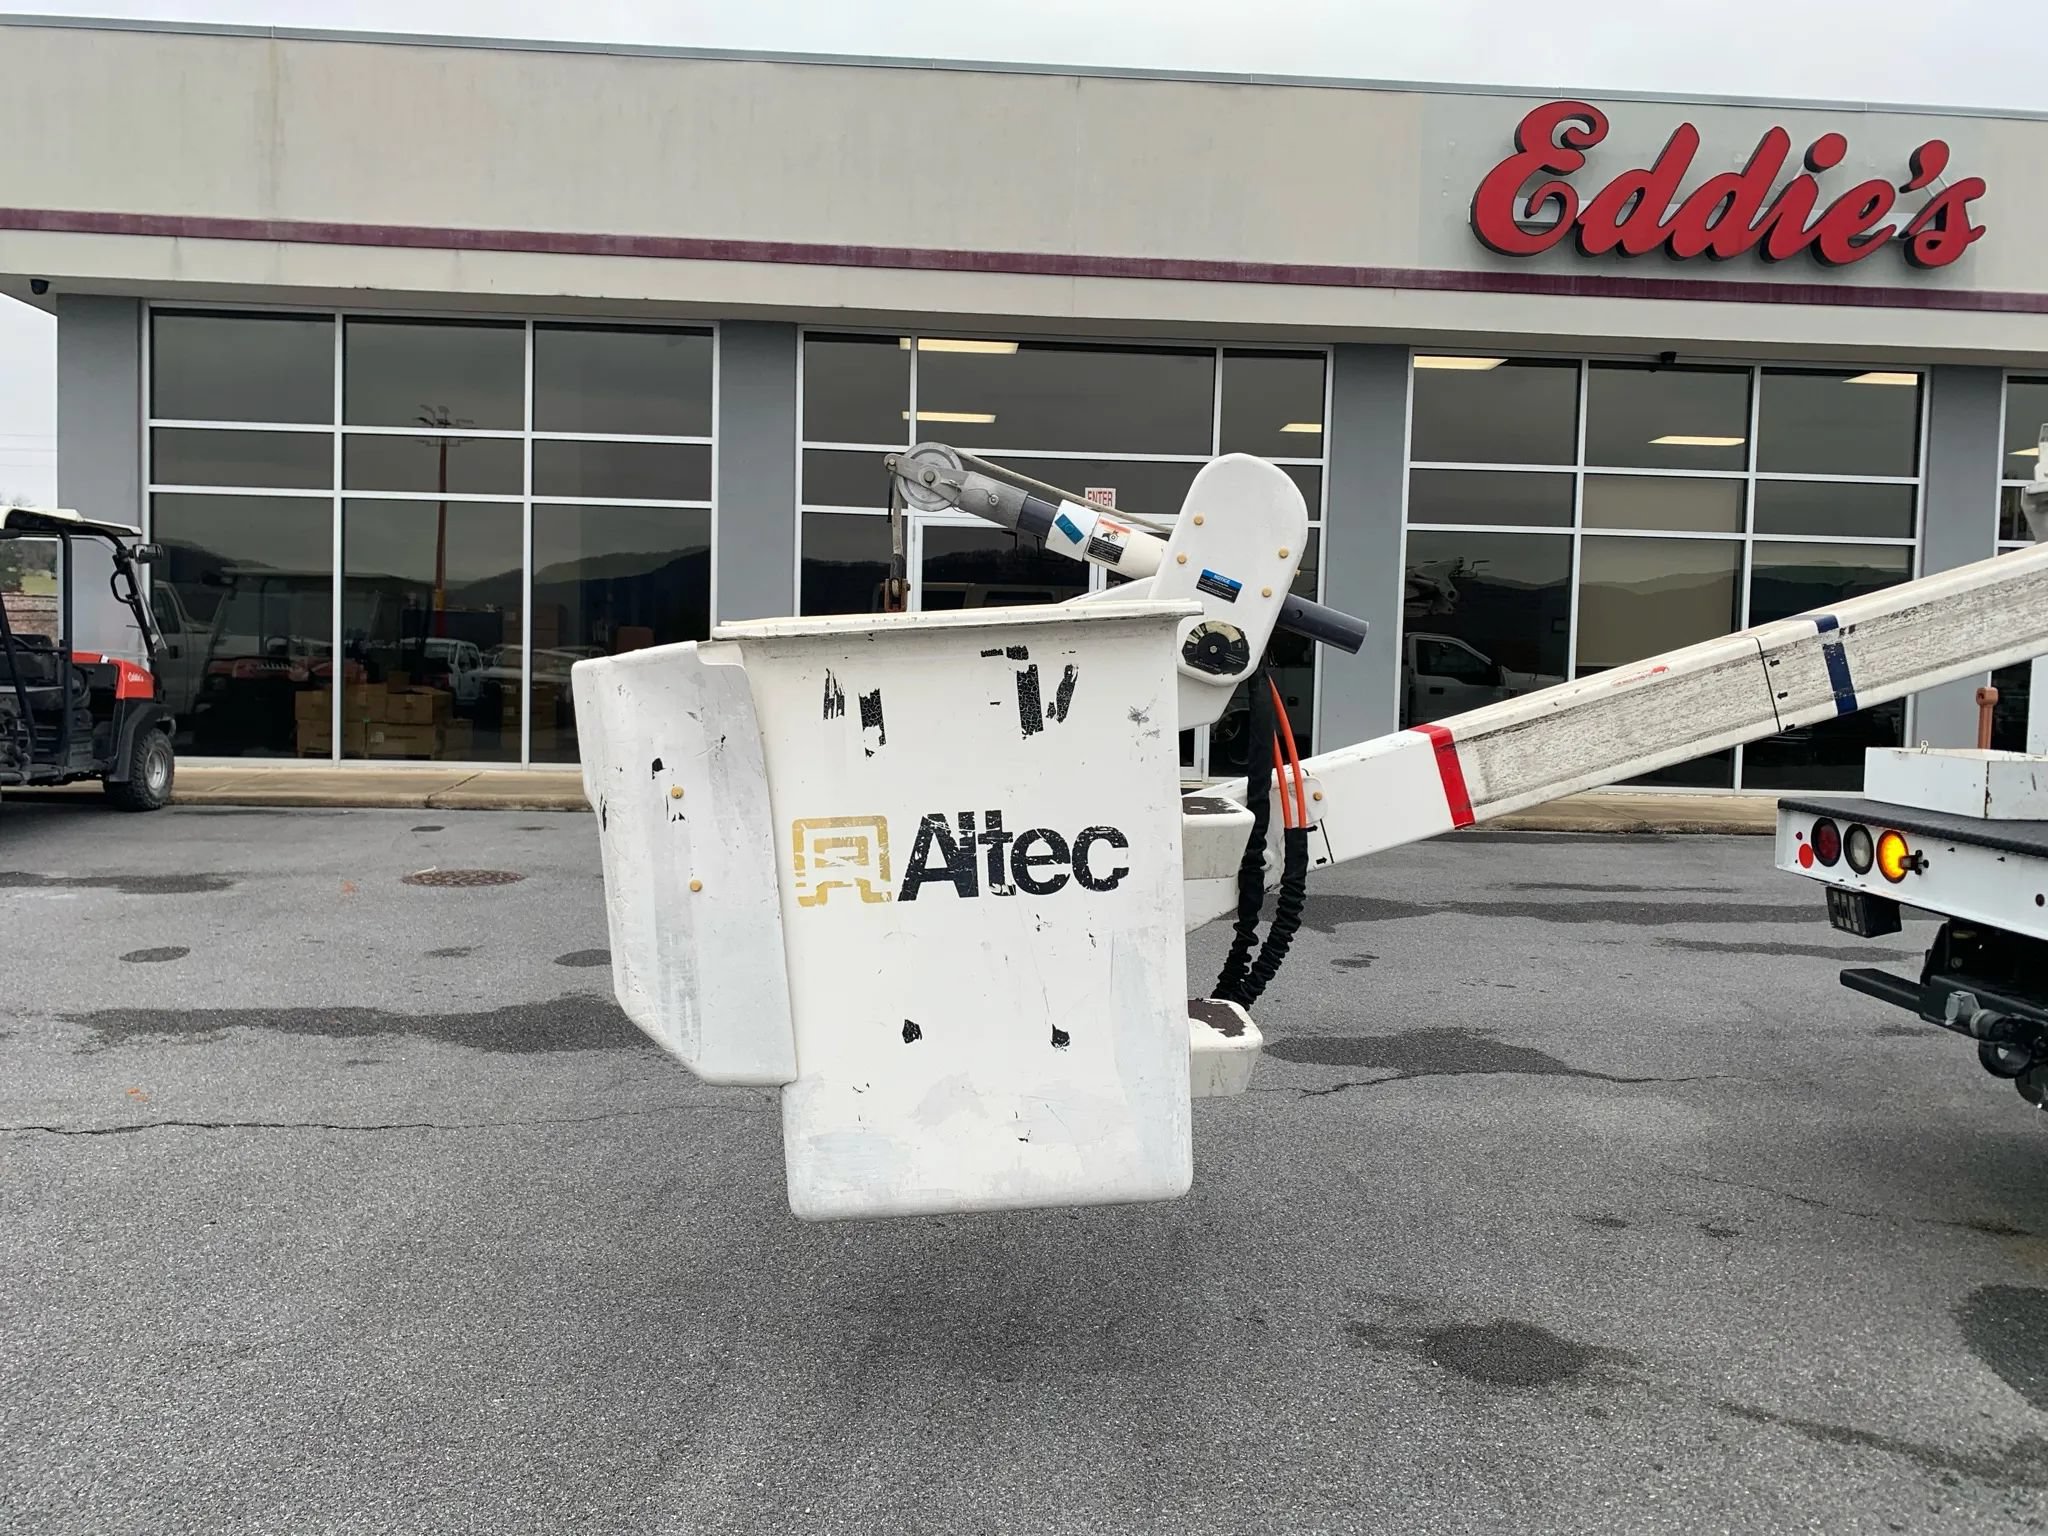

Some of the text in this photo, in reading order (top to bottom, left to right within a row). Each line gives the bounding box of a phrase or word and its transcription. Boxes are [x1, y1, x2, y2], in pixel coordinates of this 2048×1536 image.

[1471, 100, 1986, 268] Eddie's
[1087, 490, 1113, 507] ENTER
[897, 809, 1130, 902] Altec
